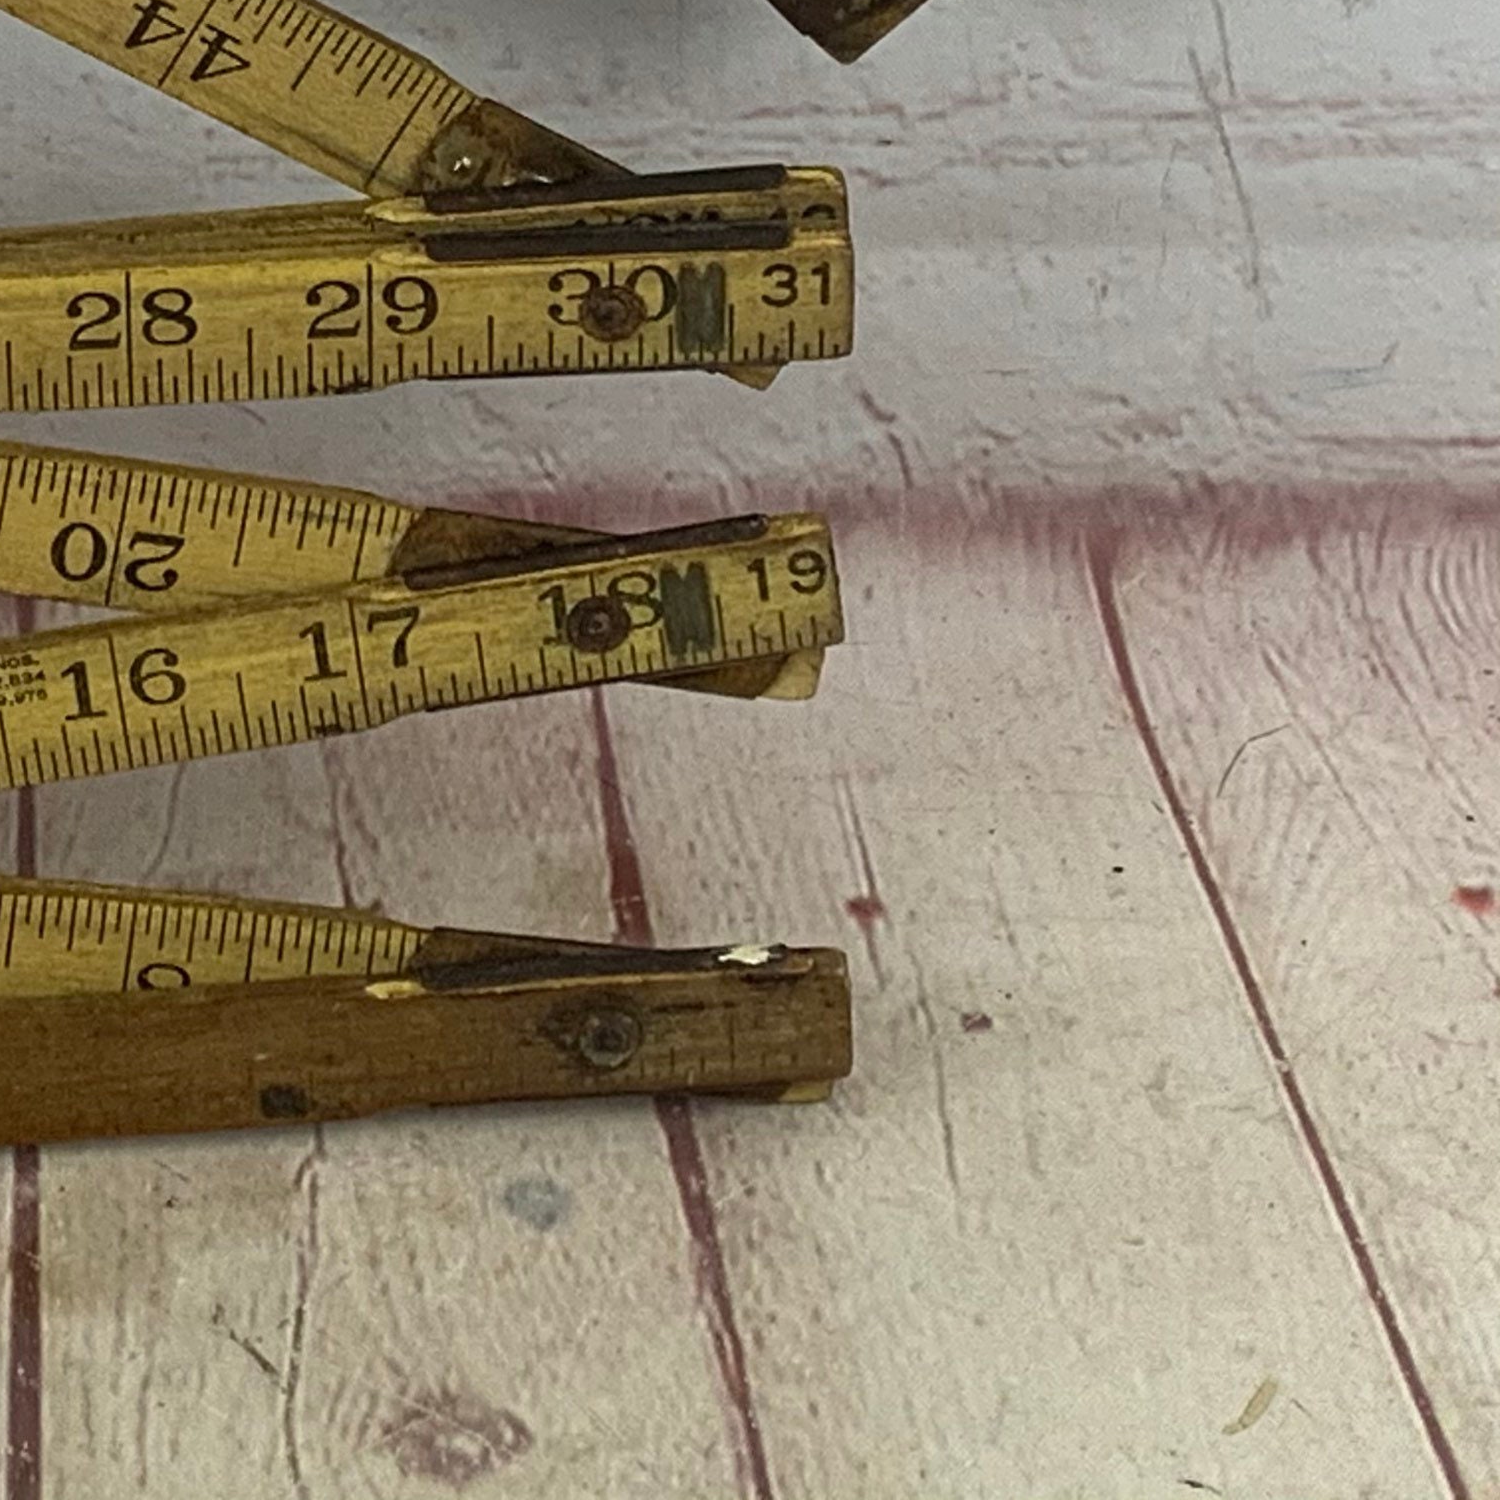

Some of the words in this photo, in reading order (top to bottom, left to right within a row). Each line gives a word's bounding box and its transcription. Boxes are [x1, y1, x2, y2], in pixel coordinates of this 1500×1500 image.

[66, 287, 199, 352] 28
[305, 276, 439, 339] 29
[547, 265, 678, 326] 30
[761, 261, 832, 308] 31
[51, 522, 186, 592] 20
[59, 647, 187, 723] 16
[298, 606, 420, 683] 17
[536, 570, 665, 647] 18
[746, 548, 826, 601] 19
